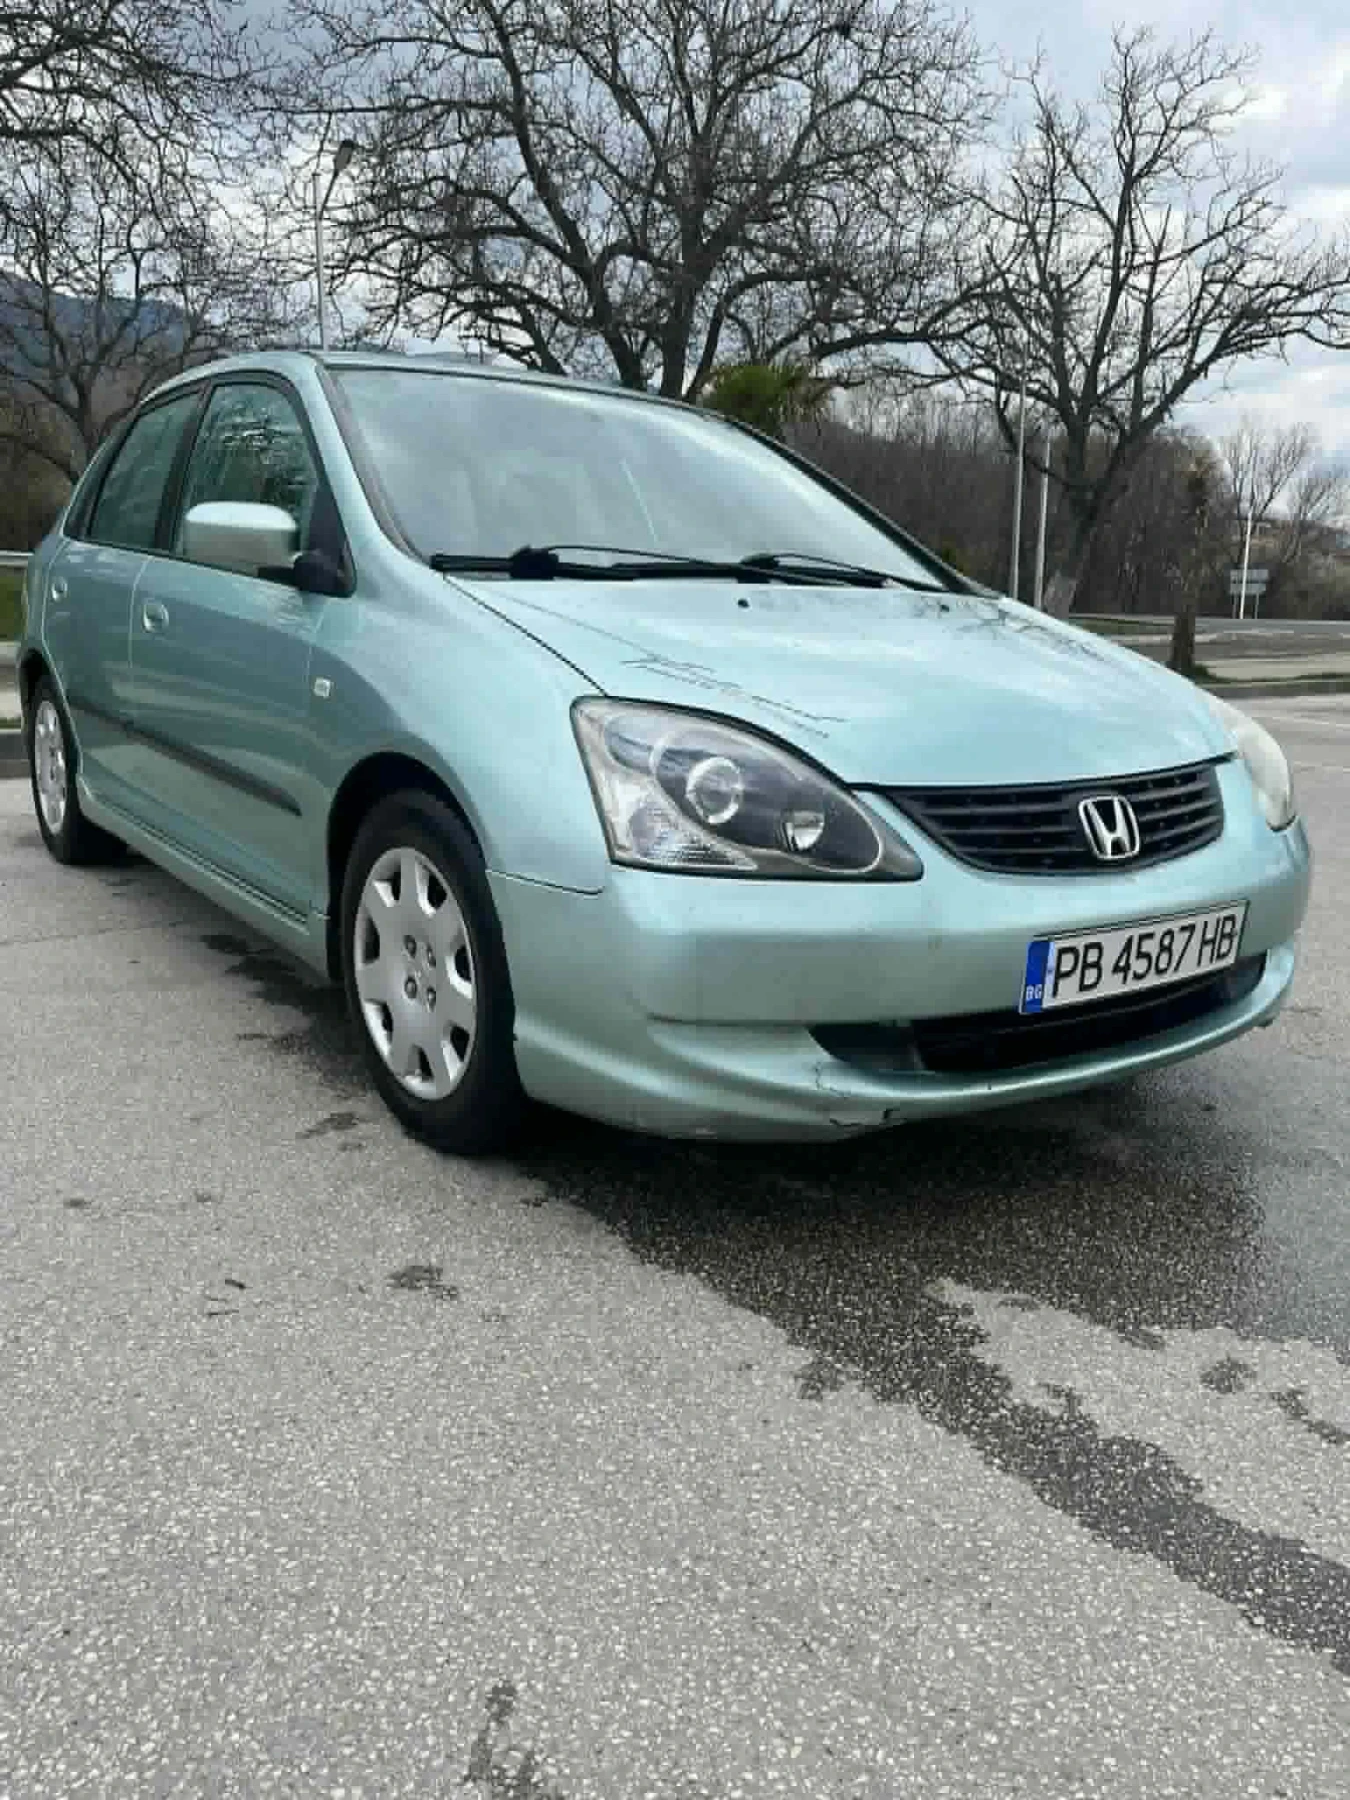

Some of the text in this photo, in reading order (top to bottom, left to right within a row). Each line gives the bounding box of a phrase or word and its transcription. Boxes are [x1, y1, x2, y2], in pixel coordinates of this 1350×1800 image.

[1052, 913, 1237, 999] PB 4587 HB
[1025, 984, 1043, 1001] BG
